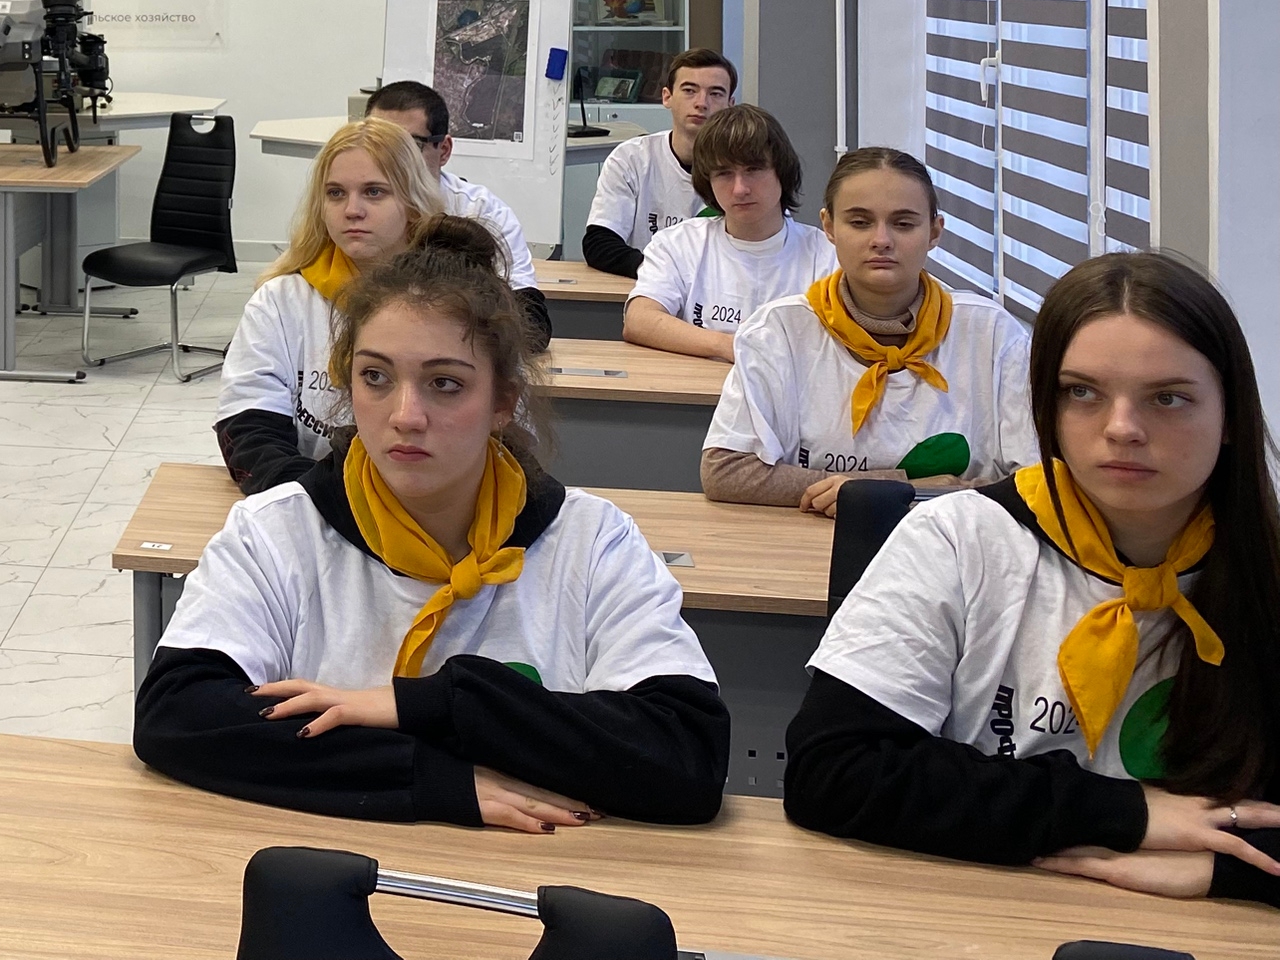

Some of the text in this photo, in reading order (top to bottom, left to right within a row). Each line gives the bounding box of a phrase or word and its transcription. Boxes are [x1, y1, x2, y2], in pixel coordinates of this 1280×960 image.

[135, 13, 197, 23] хозяйство
[711, 304, 742, 325] 2024
[824, 452, 869, 473] 2024
